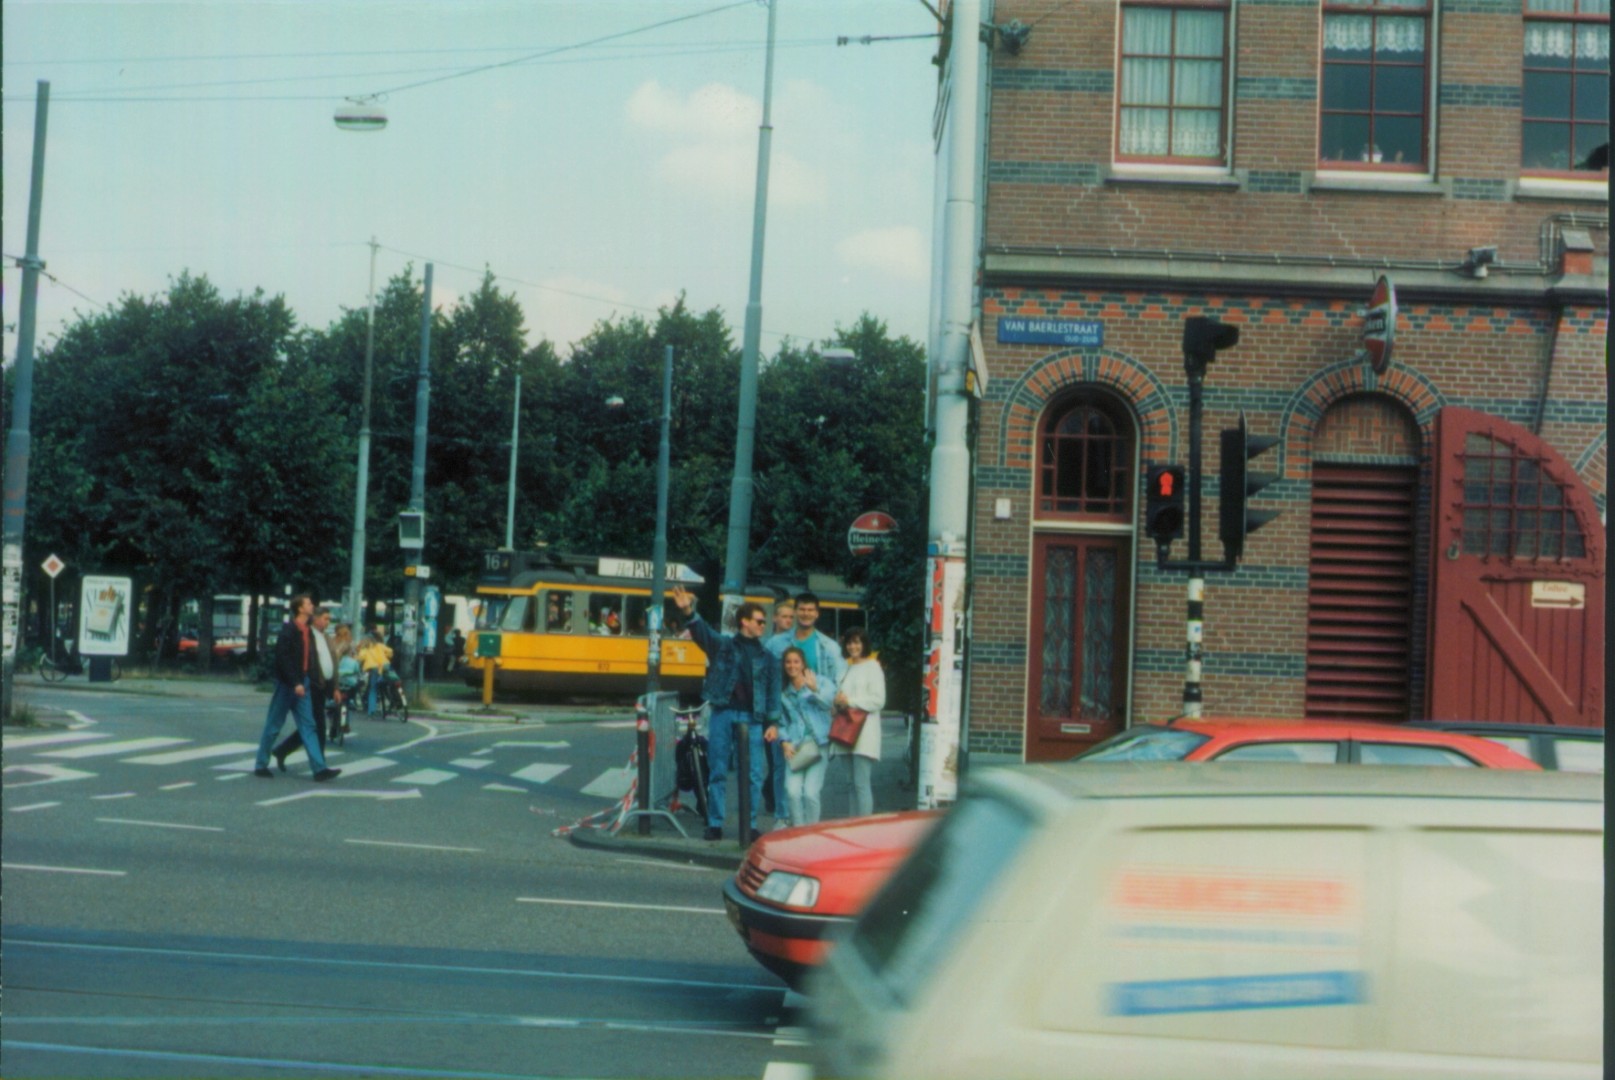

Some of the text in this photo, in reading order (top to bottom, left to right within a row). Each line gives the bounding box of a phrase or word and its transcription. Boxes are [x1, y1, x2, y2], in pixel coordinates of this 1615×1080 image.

[1004, 321, 1098, 334] VAN BAERLESTRAAT
[852, 533, 893, 544] Heine
[484, 553, 501, 570] 16
[633, 560, 681, 580] PAROL
